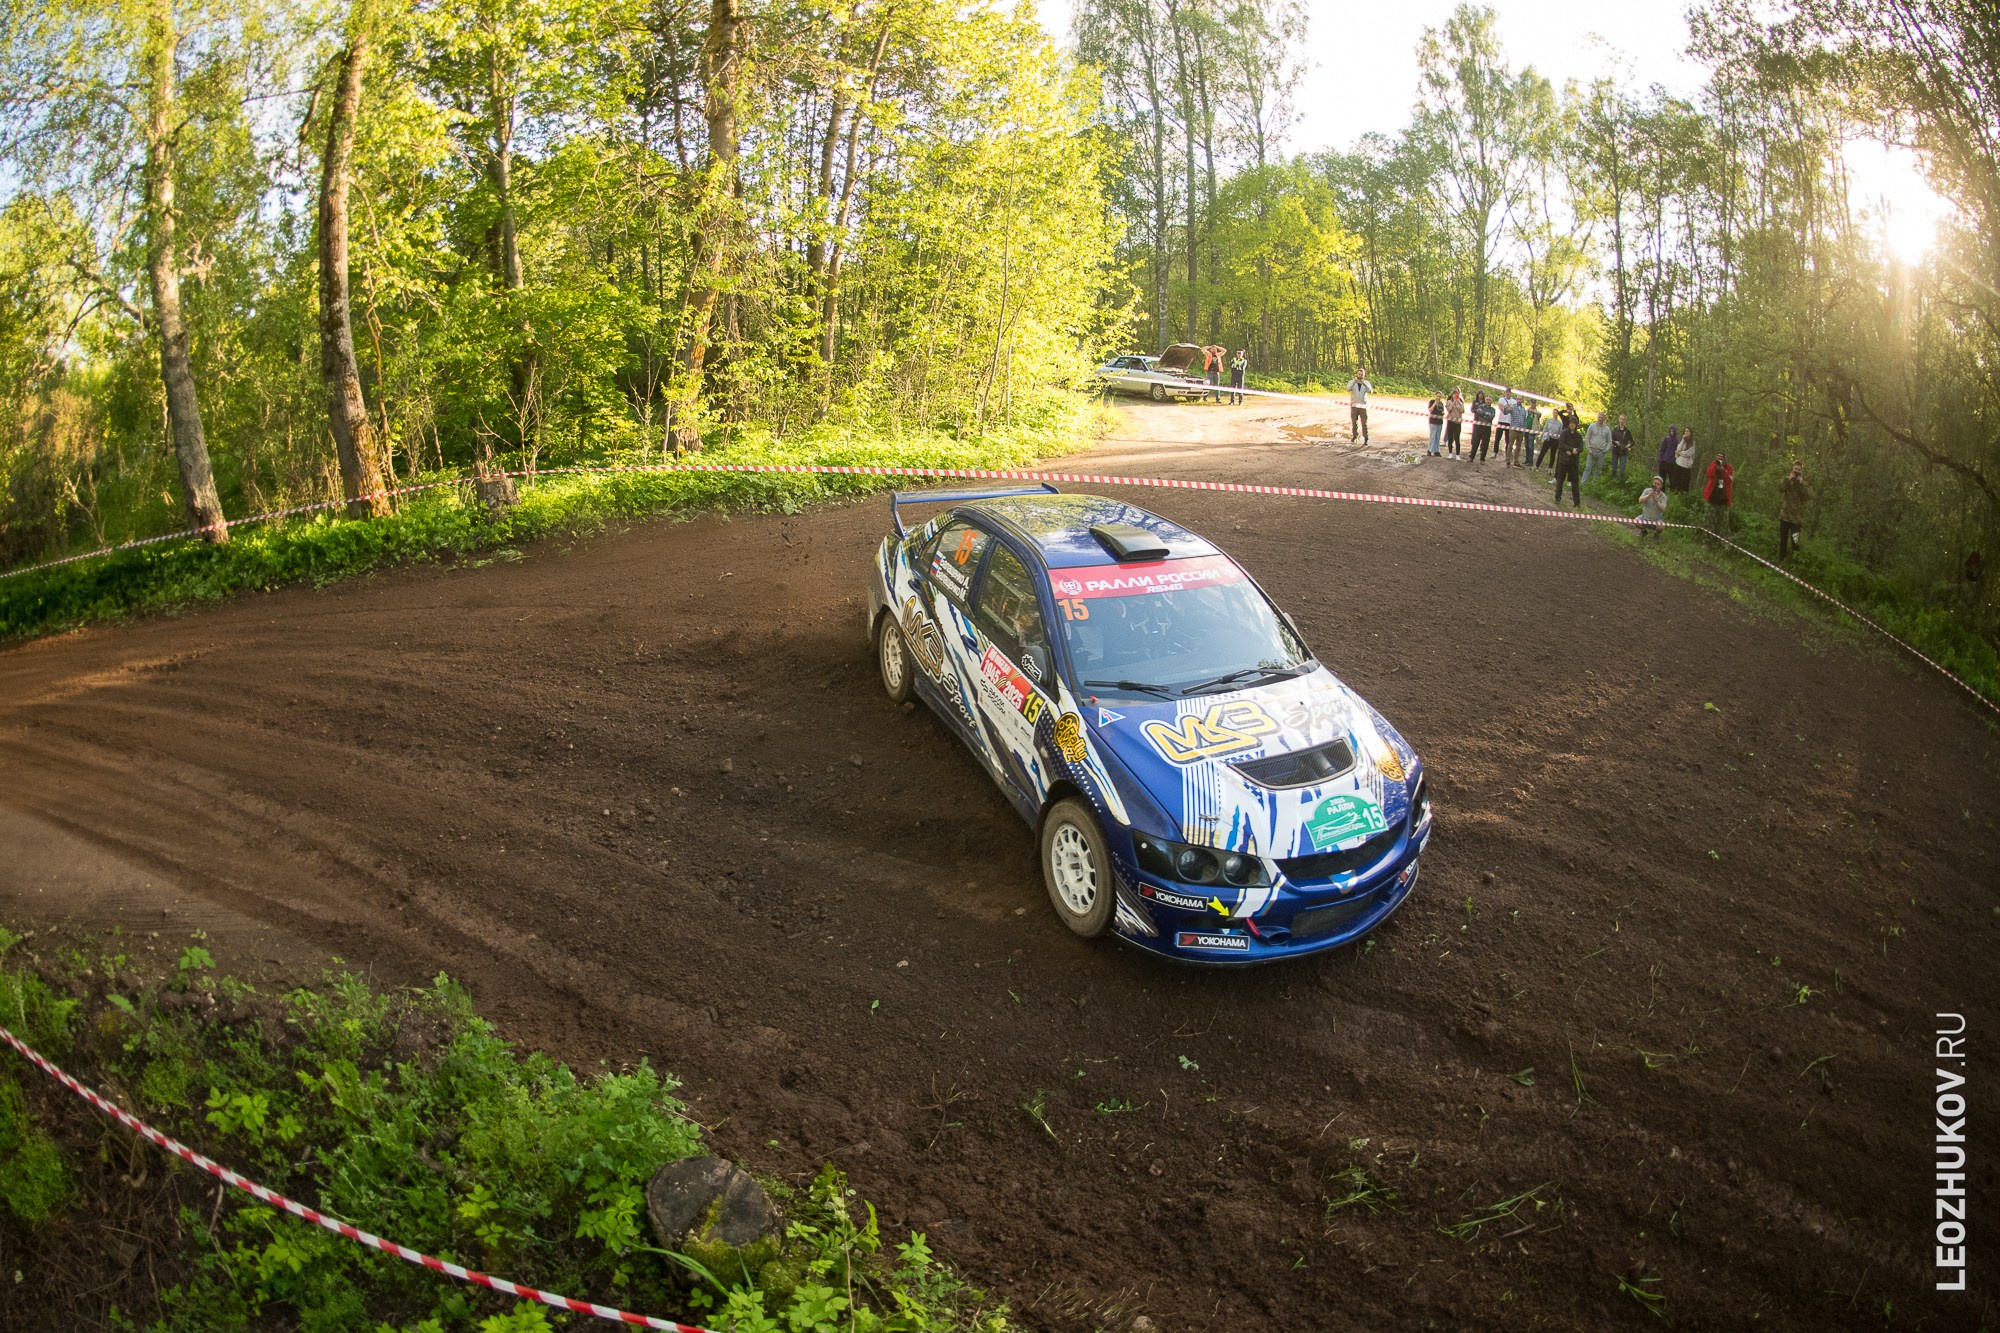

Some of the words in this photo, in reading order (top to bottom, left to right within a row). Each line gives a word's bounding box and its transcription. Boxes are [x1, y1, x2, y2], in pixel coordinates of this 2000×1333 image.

[954, 529, 977, 566] 15
[1085, 576, 1154, 592] РАЛЛИ
[1157, 569, 1221, 583] РОССИИ
[1058, 598, 1089, 621] 15
[984, 659, 1001, 685] 1945
[1002, 681, 1025, 710] 2025
[1023, 691, 1044, 723] 15
[1326, 801, 1355, 816] РАЛЛИ
[1362, 805, 1384, 830] 15
[1155, 891, 1204, 909] YOKOHAMA
[1197, 936, 1246, 948] YOKOHAMA
